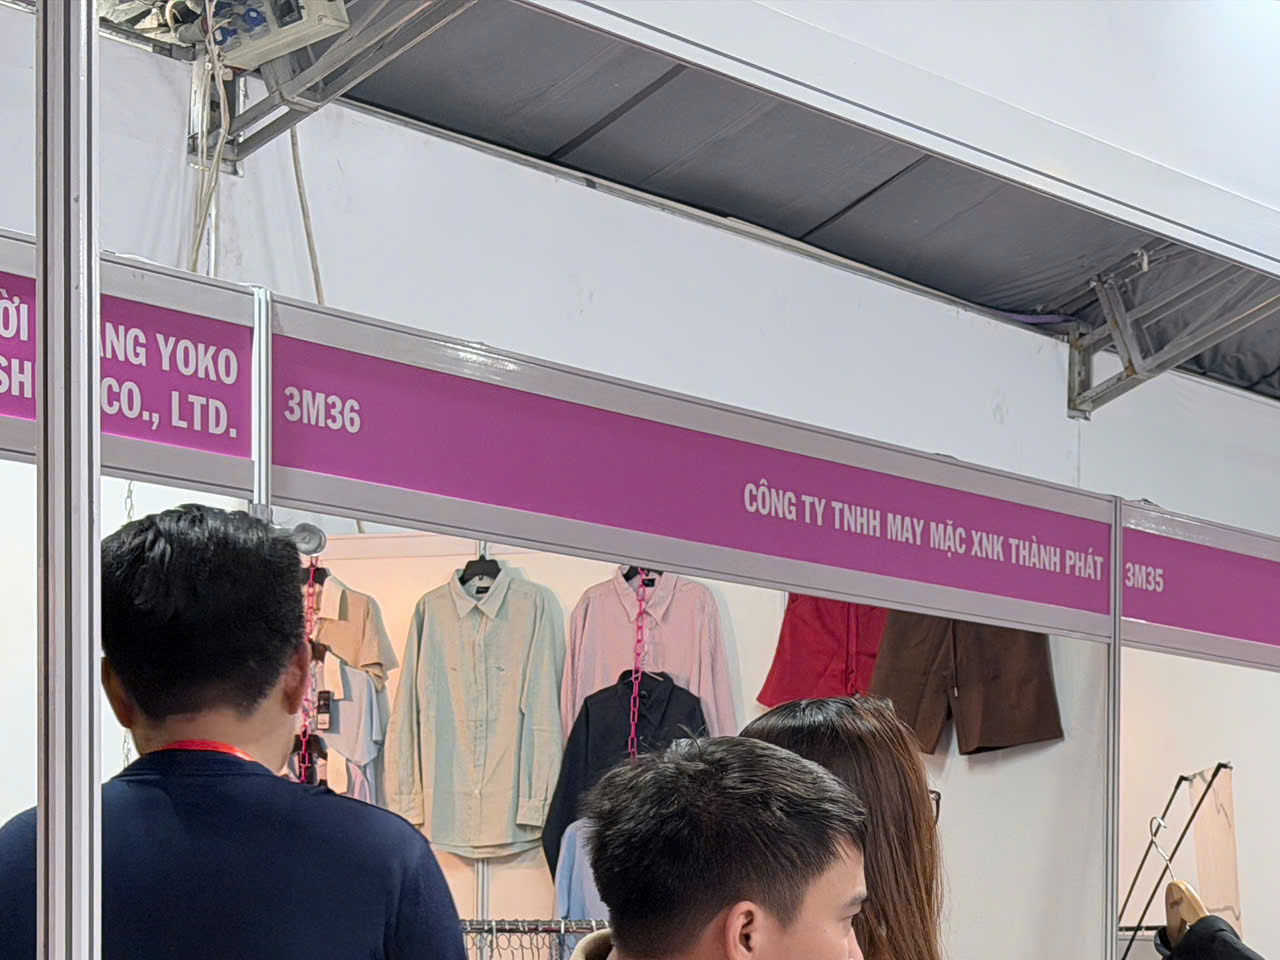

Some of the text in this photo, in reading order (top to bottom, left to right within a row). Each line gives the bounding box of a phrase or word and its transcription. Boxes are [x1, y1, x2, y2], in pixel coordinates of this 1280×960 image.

[100, 321, 147, 367] NG
[155, 333, 239, 385] YOKO
[171, 391, 238, 439] LTD.
[283, 385, 362, 433] 3M36
[743, 478, 1104, 581] CÔNG TY TNHH MAY MẶC XNK THÀNH PHÁT
[1124, 562, 1165, 594] 3M35
